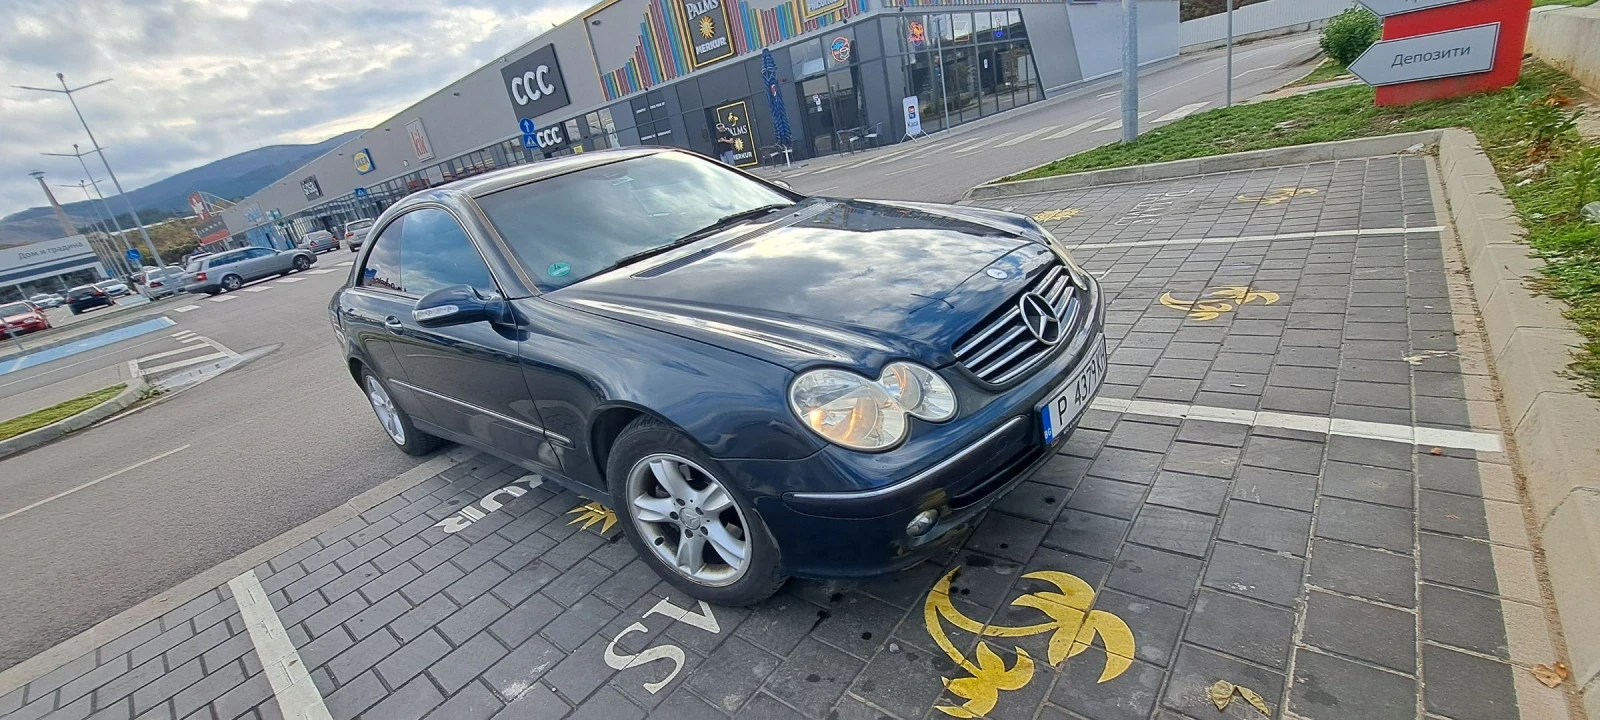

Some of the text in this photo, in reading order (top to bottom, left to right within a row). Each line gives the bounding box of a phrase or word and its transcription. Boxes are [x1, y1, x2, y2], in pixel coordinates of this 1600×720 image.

[686, 0, 719, 20] PALMS
[695, 36, 727, 55] MERKUR
[1391, 46, 1471, 68] Депозити
[511, 65, 555, 105] CCC
[536, 127, 563, 148] CCC
[726, 124, 748, 136] ALMS
[18, 252, 38, 261] Дом
[47, 241, 84, 255] градина
[1057, 395, 1068, 426] P
[1044, 428, 1053, 440] BG
